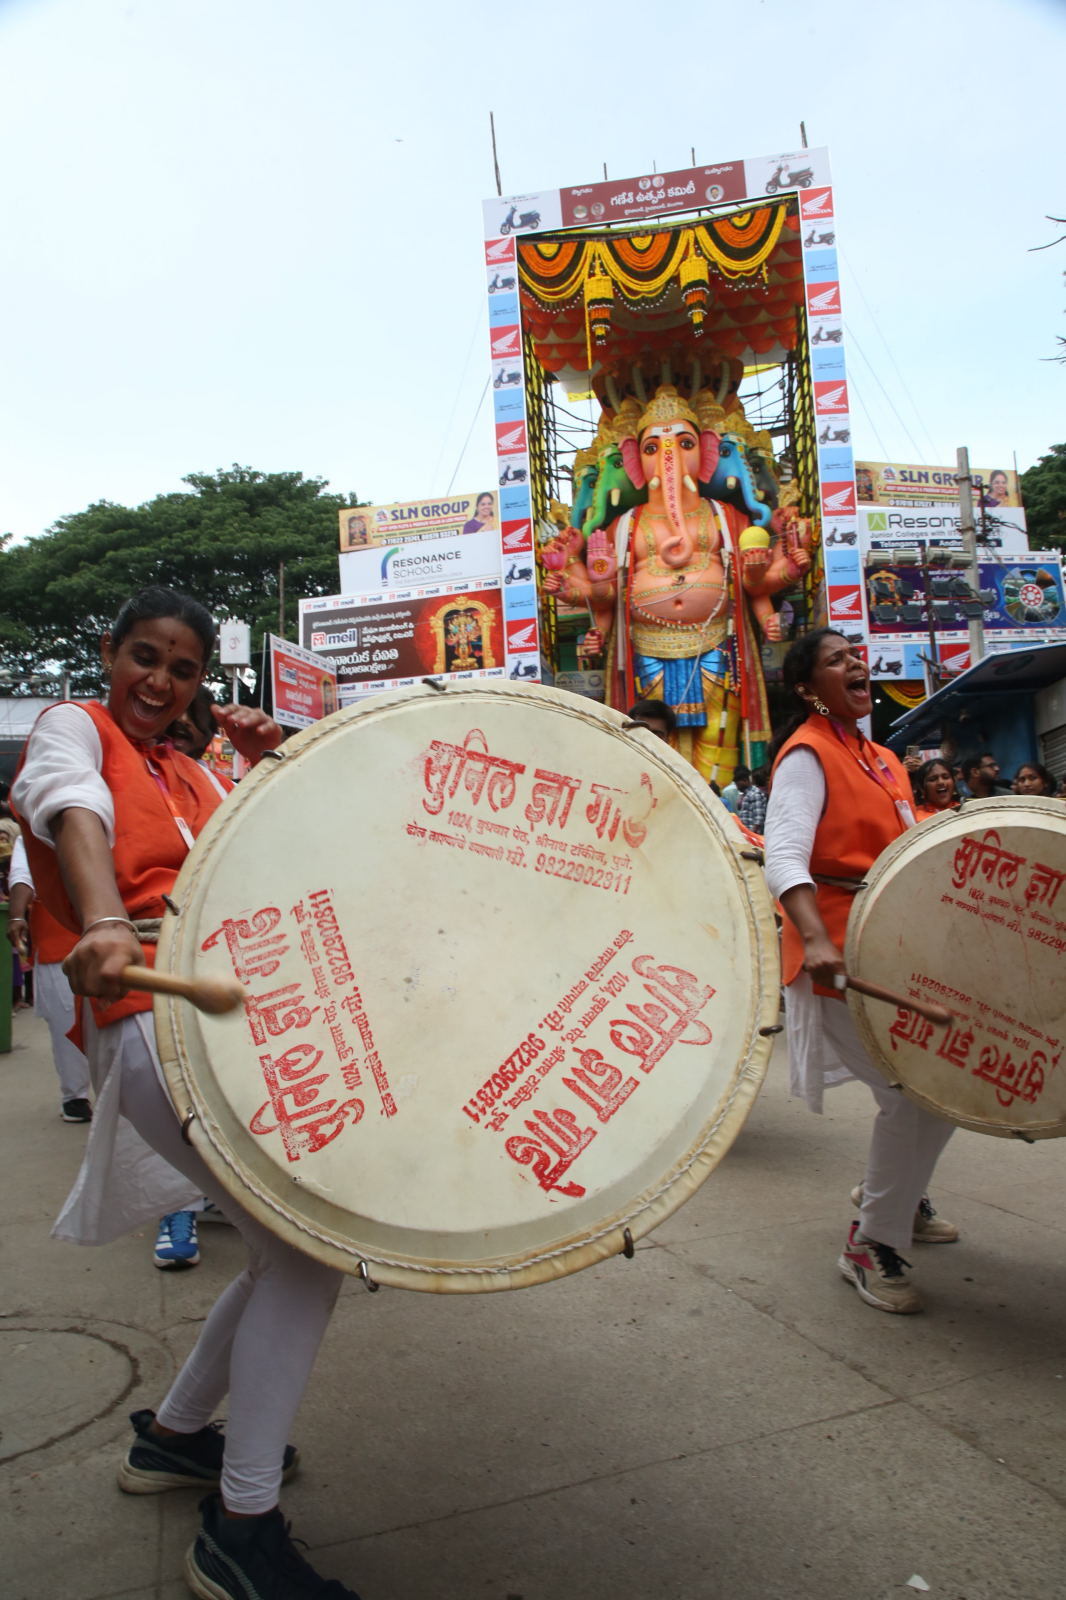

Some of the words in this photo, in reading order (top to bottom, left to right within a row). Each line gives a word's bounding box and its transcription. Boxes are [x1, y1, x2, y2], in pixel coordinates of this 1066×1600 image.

[900, 470, 929, 483] SLN
[932, 472, 983, 486] GRP
[390, 507, 419, 521] SLN
[421, 500, 470, 518] GROUP
[503, 541, 531, 549] HONDA
[392, 551, 462, 569] RESONANCE
[393, 564, 443, 579] SCHOOLS
[328, 630, 356, 644] meil
[509, 641, 537, 649] HONDA
[422, 728, 526, 815] सुनिल
[513, 825, 530, 845] पेठ,
[951, 829, 1026, 889] सुनिल
[201, 907, 290, 985] गाडे
[308, 889, 355, 986] 9822902811
[600, 971, 630, 999] 1024,
[578, 994, 610, 1029] बुधवार
[609, 954, 717, 1074] सुनिल
[561, 1027, 587, 1045] पेठ,
[536, 1046, 566, 1077] श्रीनाथ
[971, 1049, 1044, 1107] सुनिल
[250, 1043, 365, 1162] सुनिल
[505, 1108, 598, 1198] गाडे
